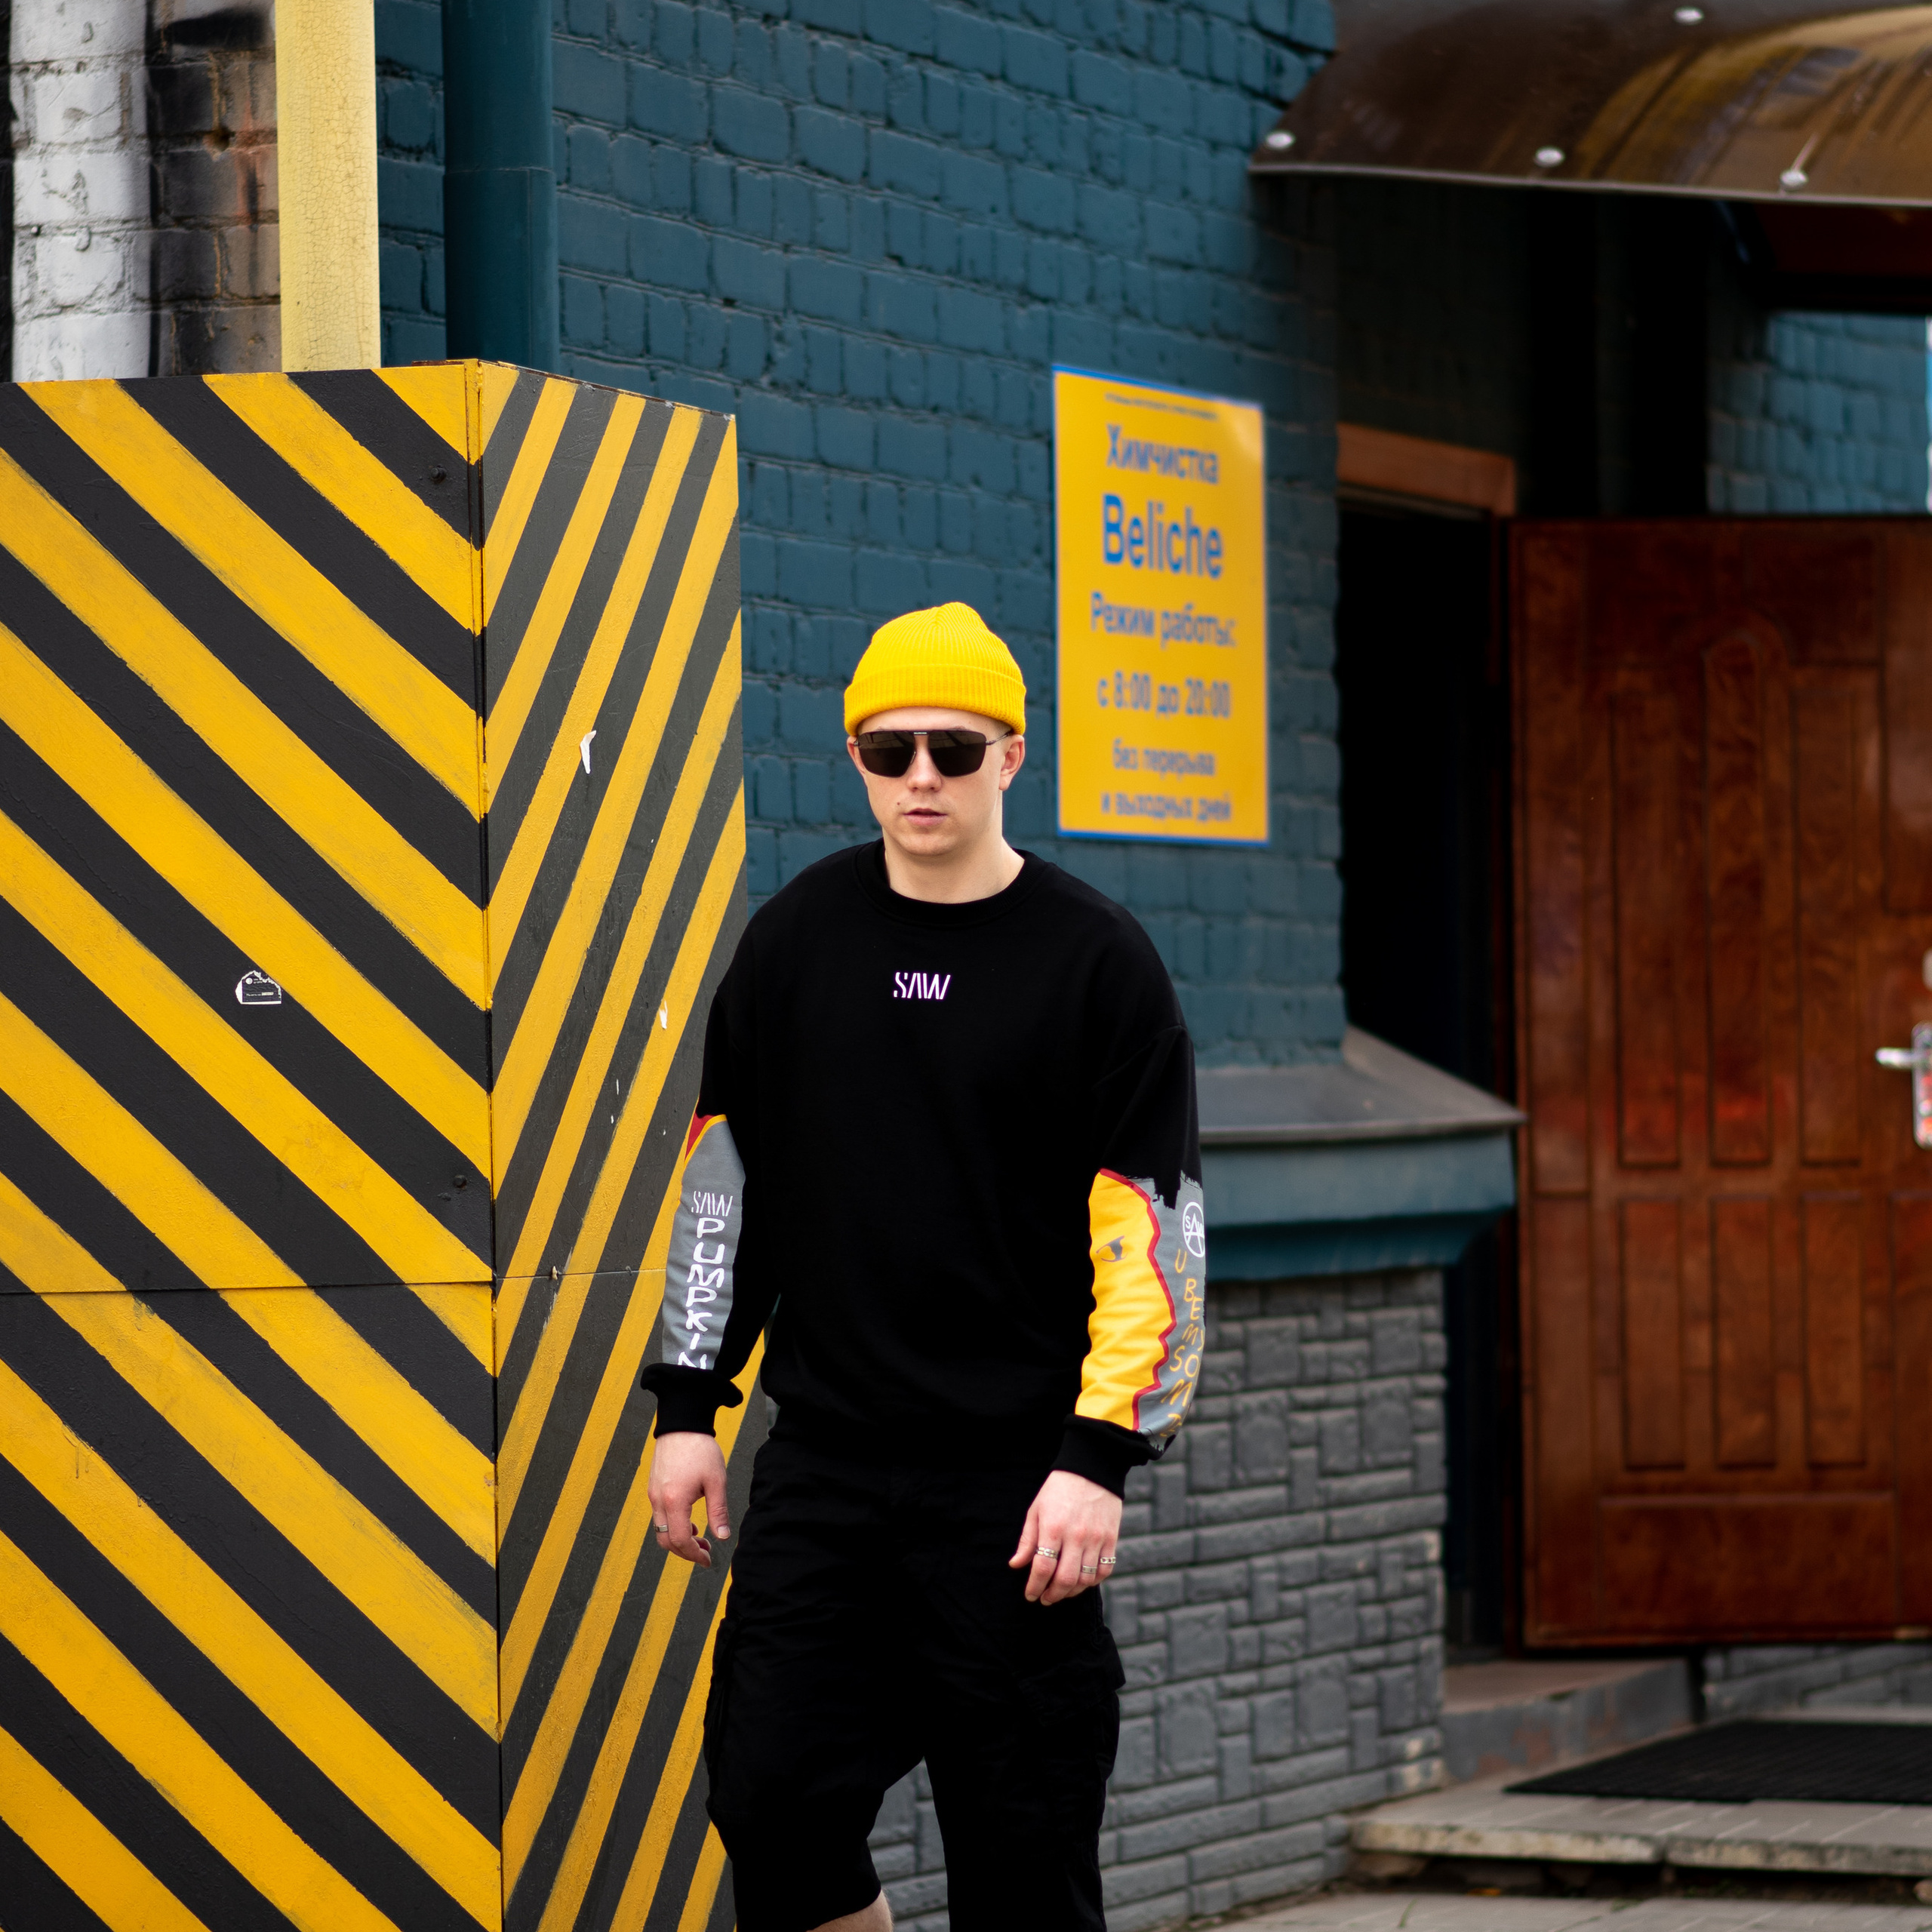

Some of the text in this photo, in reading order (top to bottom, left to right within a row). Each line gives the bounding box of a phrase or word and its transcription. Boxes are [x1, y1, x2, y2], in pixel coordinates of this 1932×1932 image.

[1106, 423, 1218, 485] Химчистка
[1102, 494, 1223, 579] Beliche
[1091, 591, 1155, 638] Режим
[1156, 685, 1180, 719] до
[1112, 737, 1138, 771] без
[893, 971, 951, 1000] SAW
[691, 1190, 734, 1217] SAW
